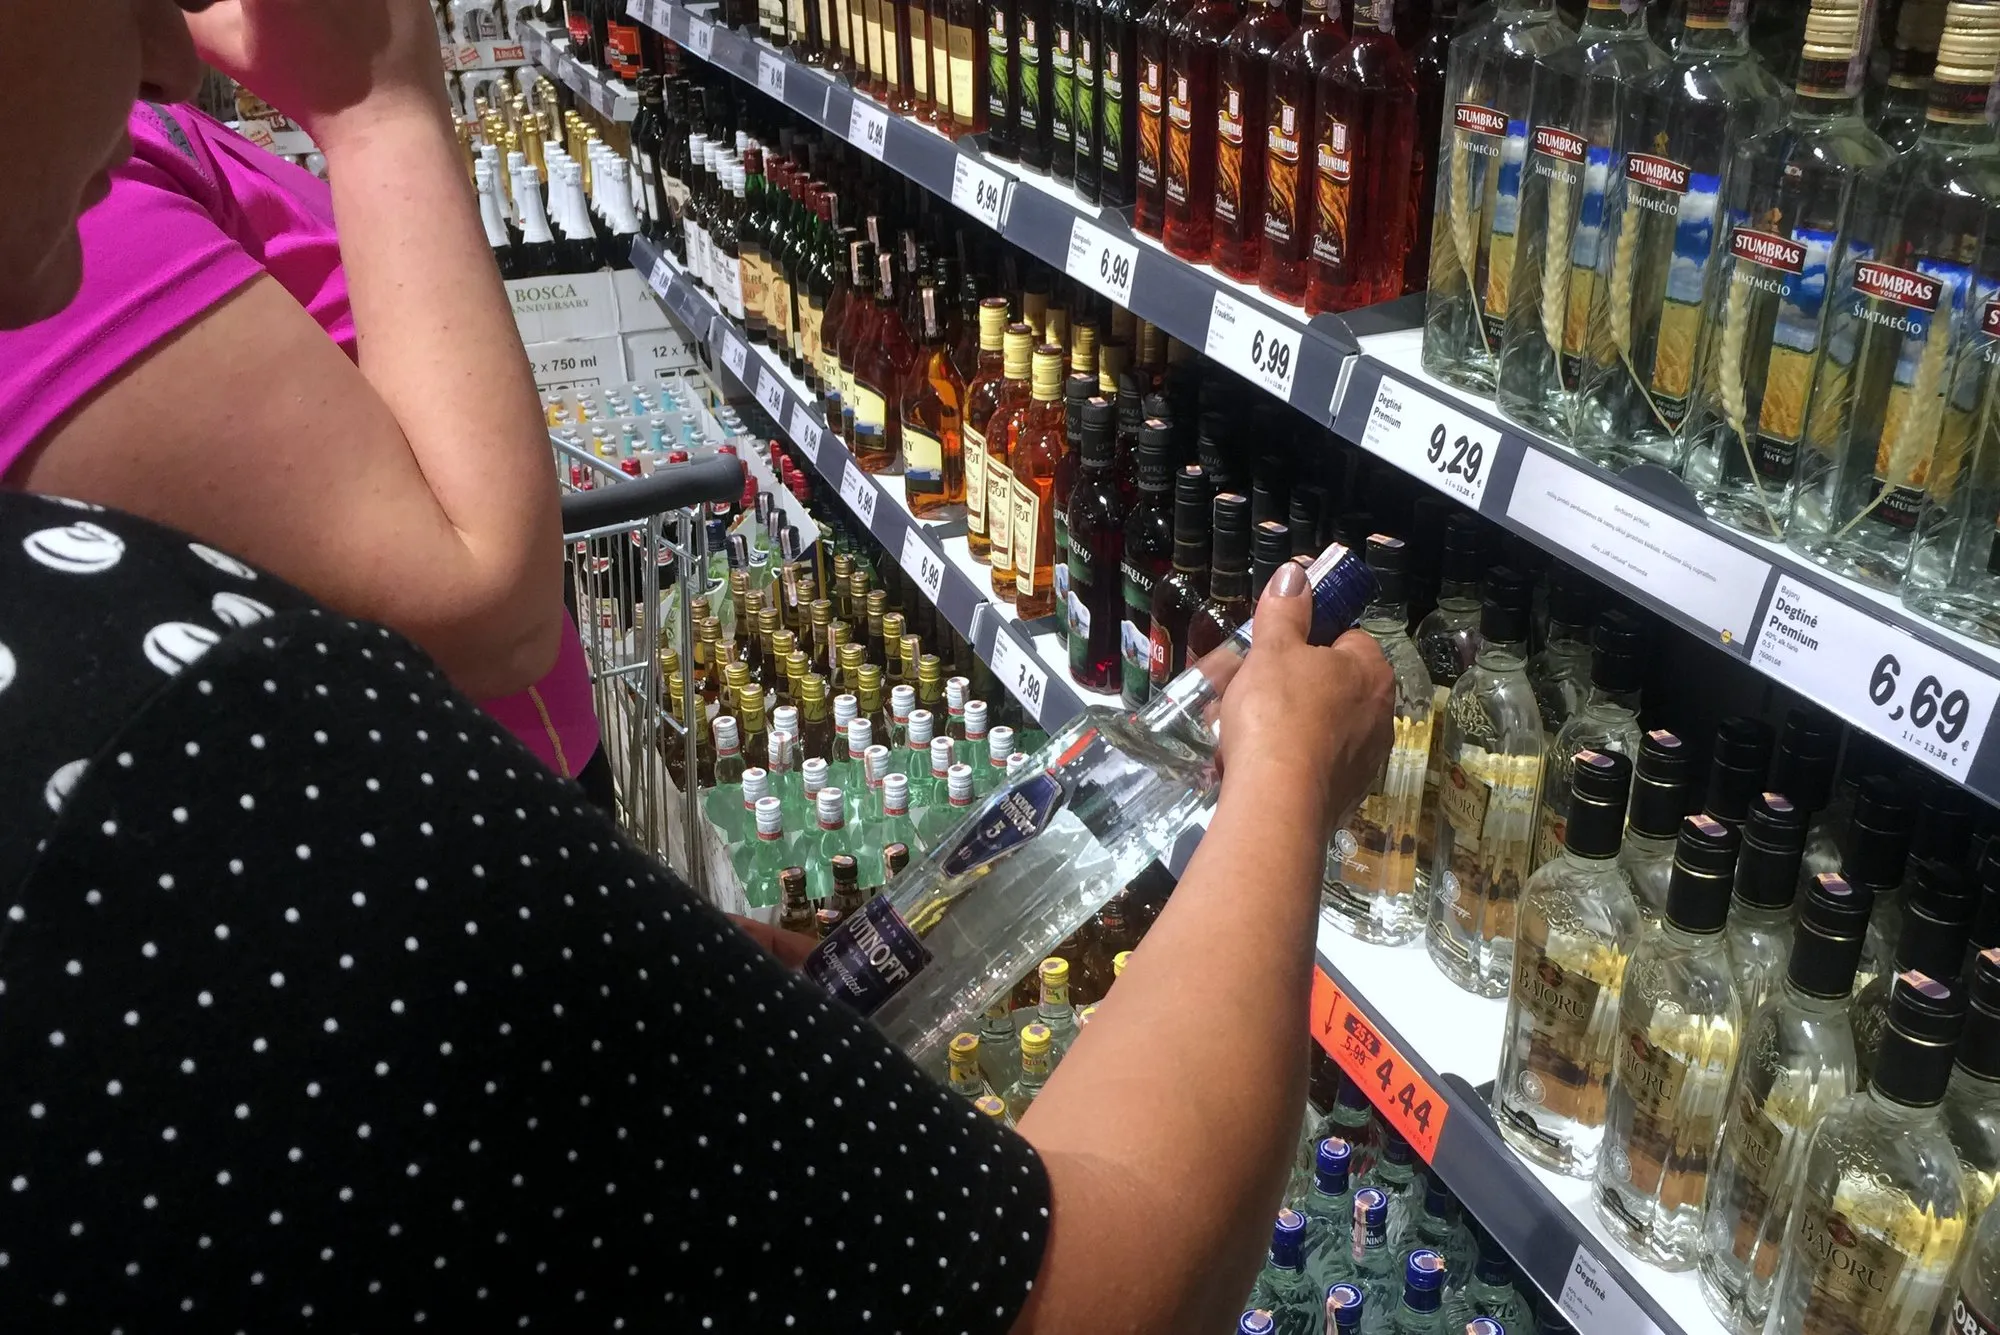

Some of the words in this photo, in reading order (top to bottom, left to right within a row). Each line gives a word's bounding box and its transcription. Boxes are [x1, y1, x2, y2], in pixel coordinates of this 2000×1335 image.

[1457, 108, 1504, 130] STUMBRAS
[1536, 131, 1583, 156] STUMBRAS
[1629, 158, 1685, 185] STUMBRAS
[977, 179, 998, 213] 8,99
[1735, 234, 1800, 265] STUMBRAS
[1100, 247, 1129, 289] 6,99
[1857, 267, 1934, 301] STUMBRAS
[514, 284, 577, 303] BOSCA
[1852, 301, 1923, 335] ŠIMTMEČIO
[541, 364, 548, 372] x
[552, 357, 576, 371] 750
[580, 355, 597, 368] ml
[652, 346, 668, 358] 12
[671, 347, 679, 356] x
[1252, 329, 1290, 379] 6,99
[1373, 406, 1402, 429] Premium
[1378, 393, 1402, 412] Degtinė
[1427, 422, 1484, 484] 9,29
[921, 555, 940, 591] 6,99
[1775, 597, 1818, 628] Degtinė
[1769, 615, 1819, 651] Premium
[1018, 663, 1041, 705] 7,99
[1869, 653, 1970, 744] 6,69
[1923, 741, 1948, 761] 13,38
[1951, 757, 1959, 767] €
[1961, 740, 1970, 752] €
[1012, 791, 1037, 820] VODKA
[822, 941, 869, 997] Oxygenated
[1350, 1019, 1376, 1051] -25%
[1375, 1058, 1433, 1136] 4,44
[1574, 1263, 1607, 1302] Degtinė
